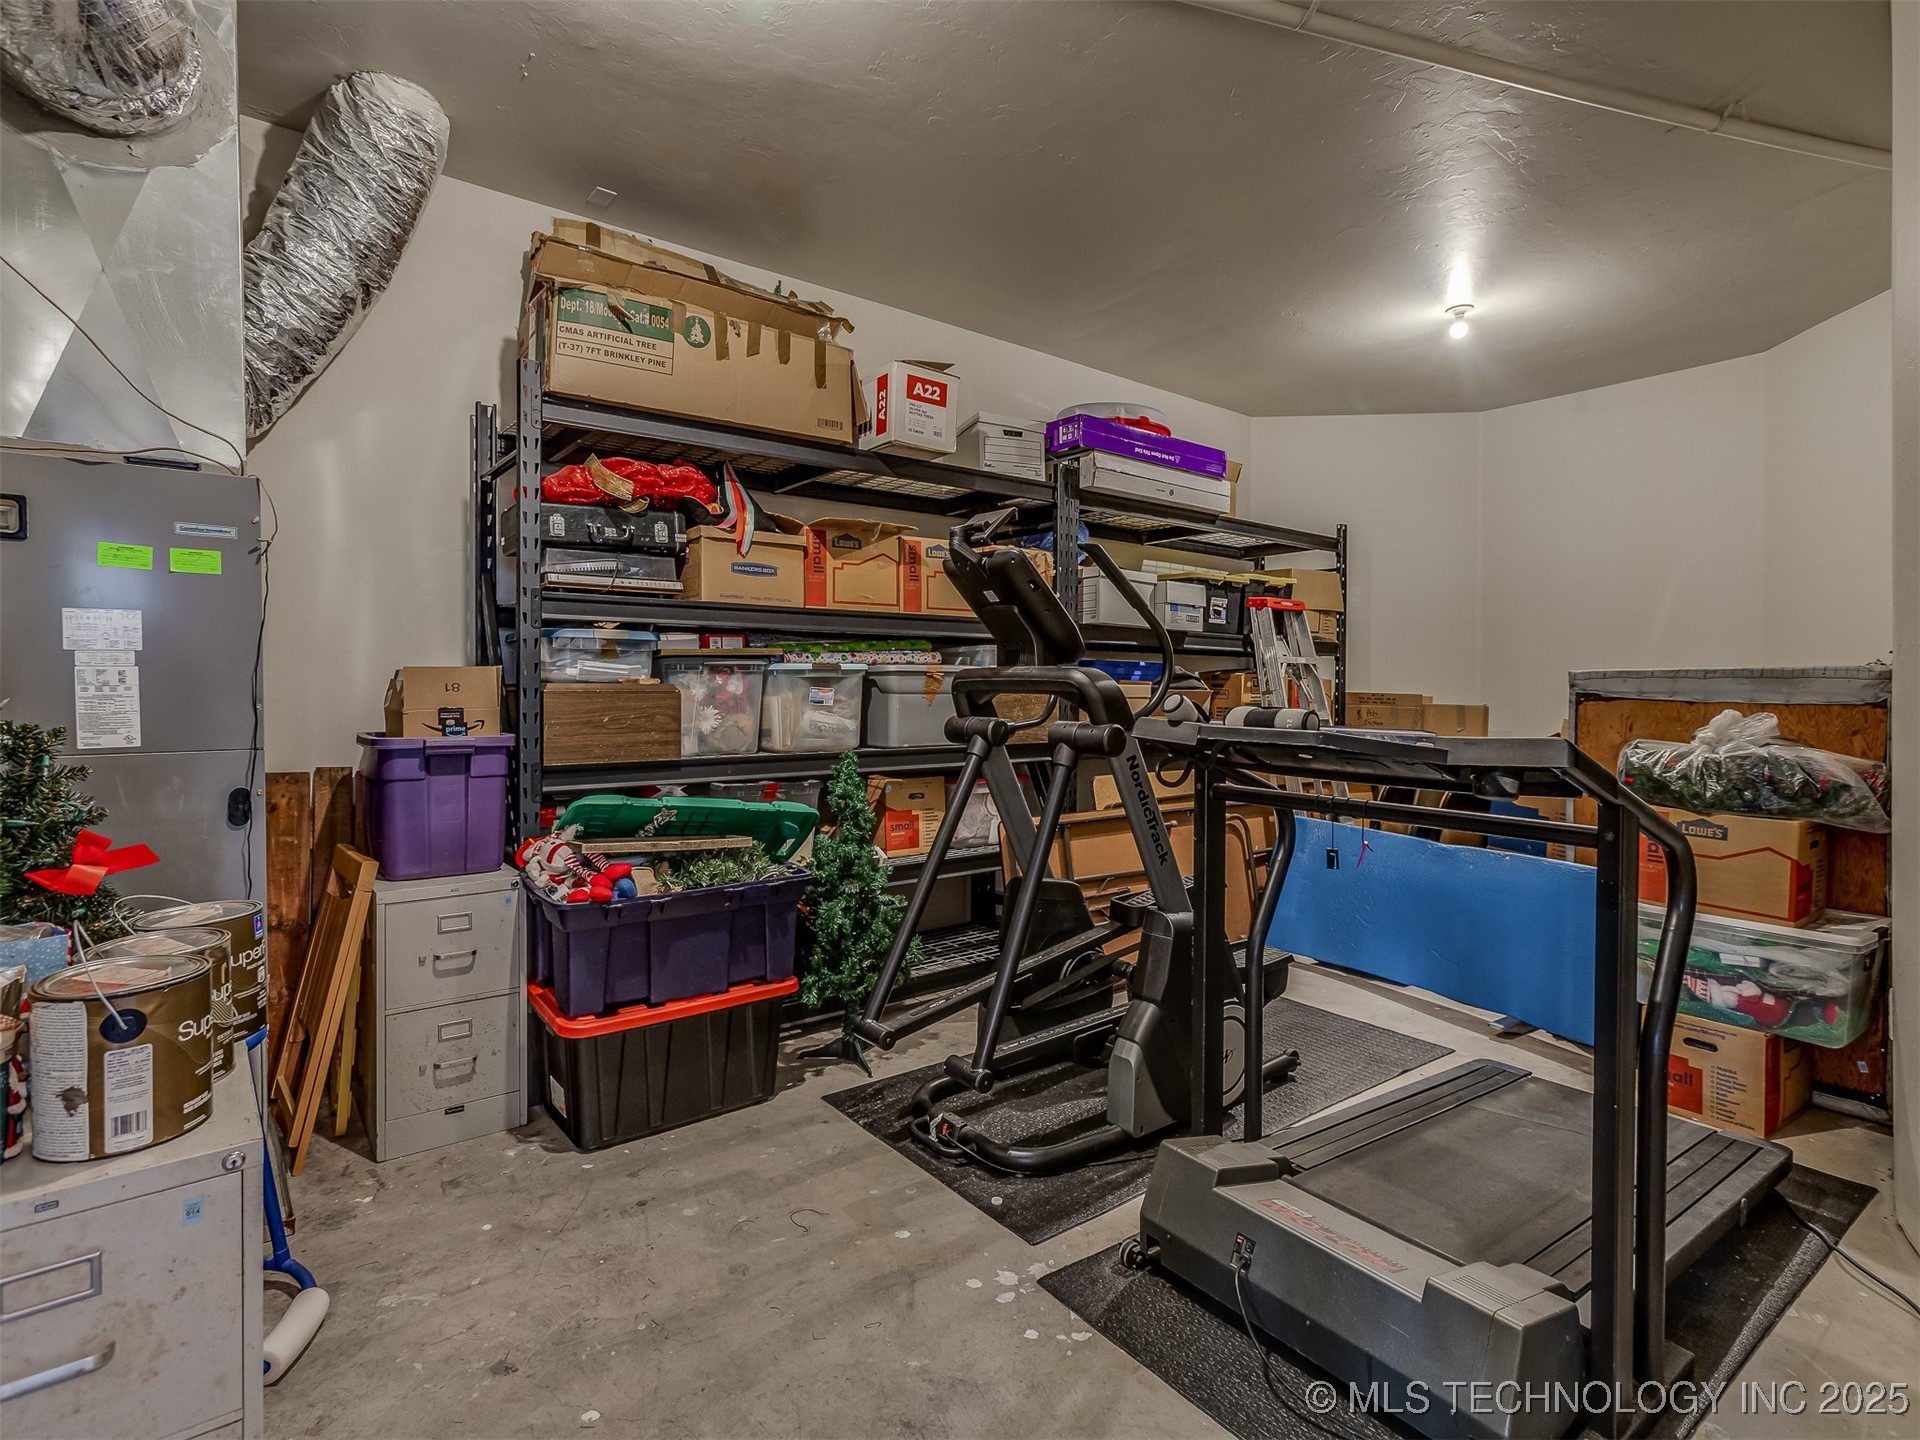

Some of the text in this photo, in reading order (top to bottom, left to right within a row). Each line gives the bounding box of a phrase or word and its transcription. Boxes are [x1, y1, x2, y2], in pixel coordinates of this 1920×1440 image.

[560, 296, 582, 313] Dept.
[651, 314, 670, 330] 0054
[559, 325, 657, 351] CMAS ARTIFICIAL TREE
[558, 341, 666, 368] (T-37) 7FT BRINKLEY PINE
[912, 382, 941, 401] A22
[878, 389, 887, 420] A22
[909, 545, 919, 581] small
[446, 725, 466, 733] prime
[1126, 754, 1169, 866] NordicTrack
[890, 820, 914, 831] small
[1681, 824, 1723, 838] LOWE'S
[1647, 842, 1664, 864] all
[1671, 1072, 1693, 1086] all
